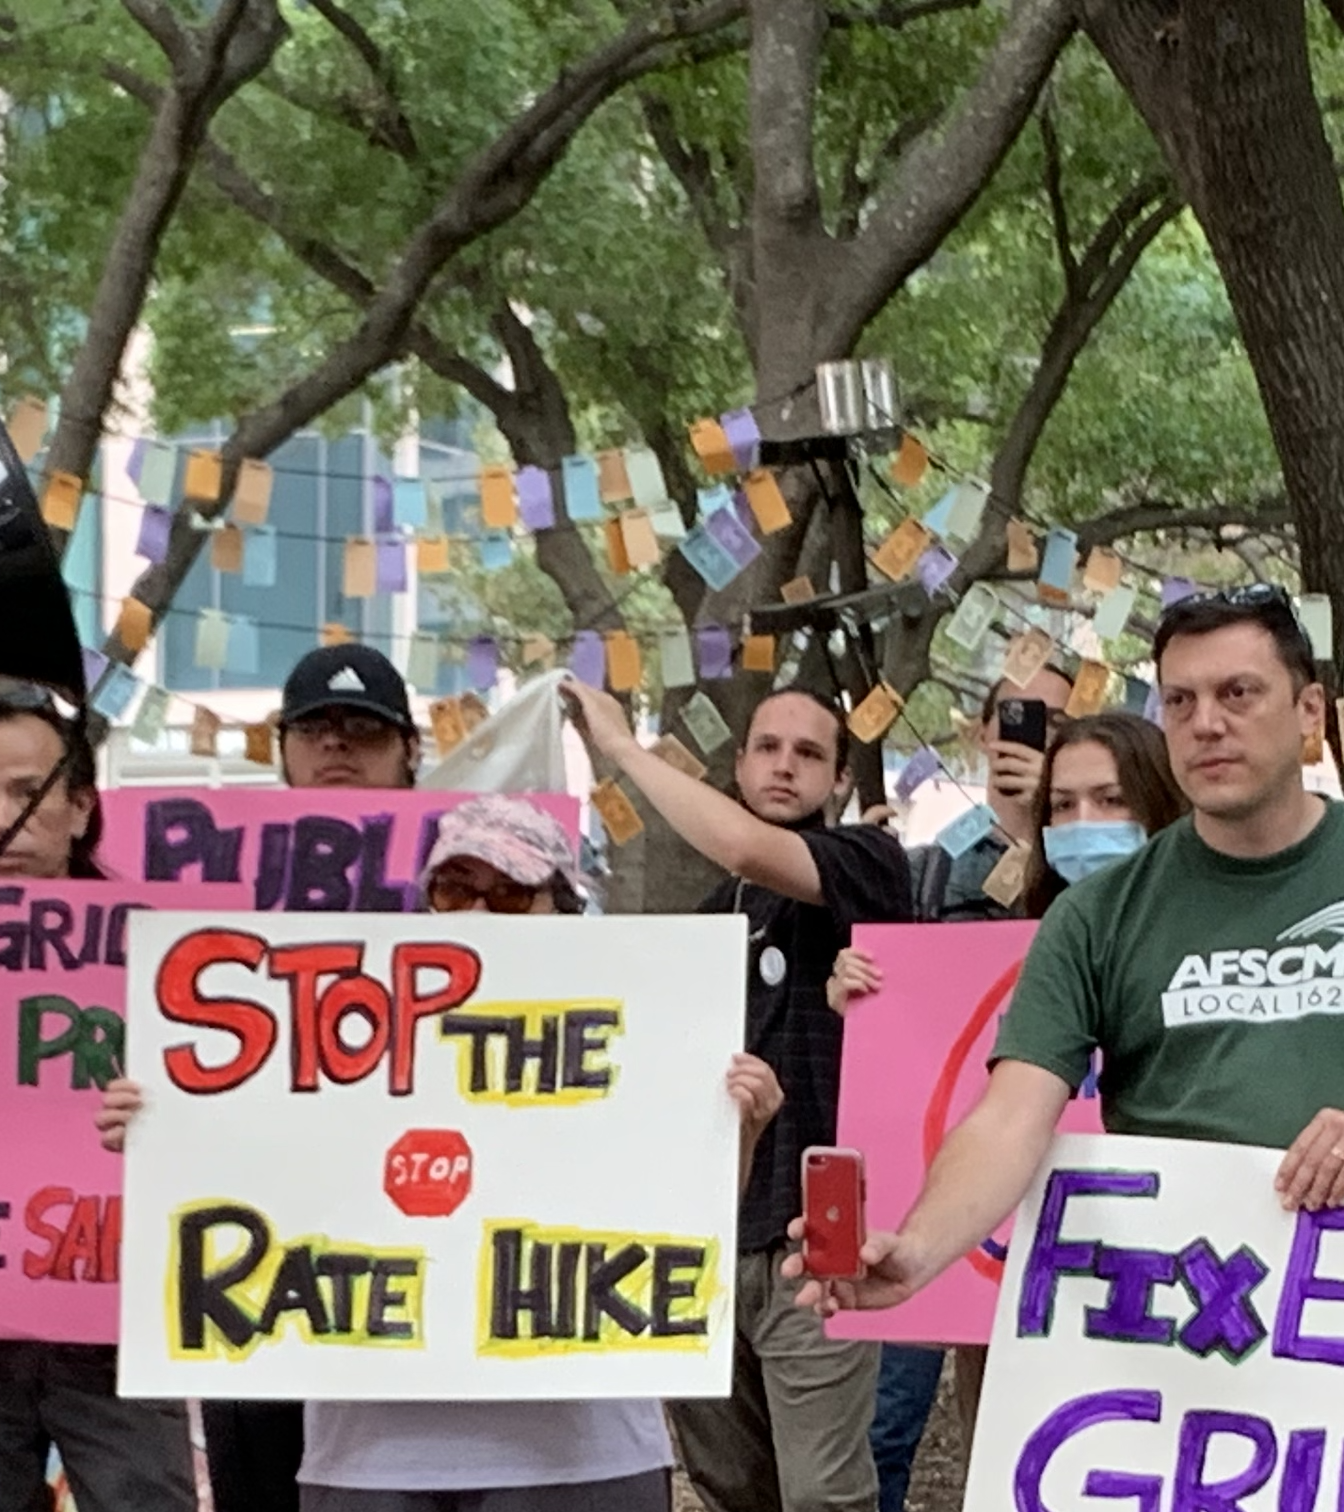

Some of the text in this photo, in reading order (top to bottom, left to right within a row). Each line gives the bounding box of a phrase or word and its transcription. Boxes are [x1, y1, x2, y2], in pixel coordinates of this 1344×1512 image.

[156, 928, 619, 1097] STOP THE
[1183, 992, 1282, 1017] LOCAL
[392, 1153, 469, 1186] STOP
[178, 1204, 710, 1350] RATE HIKE
[1017, 1167, 1269, 1366] FIX
